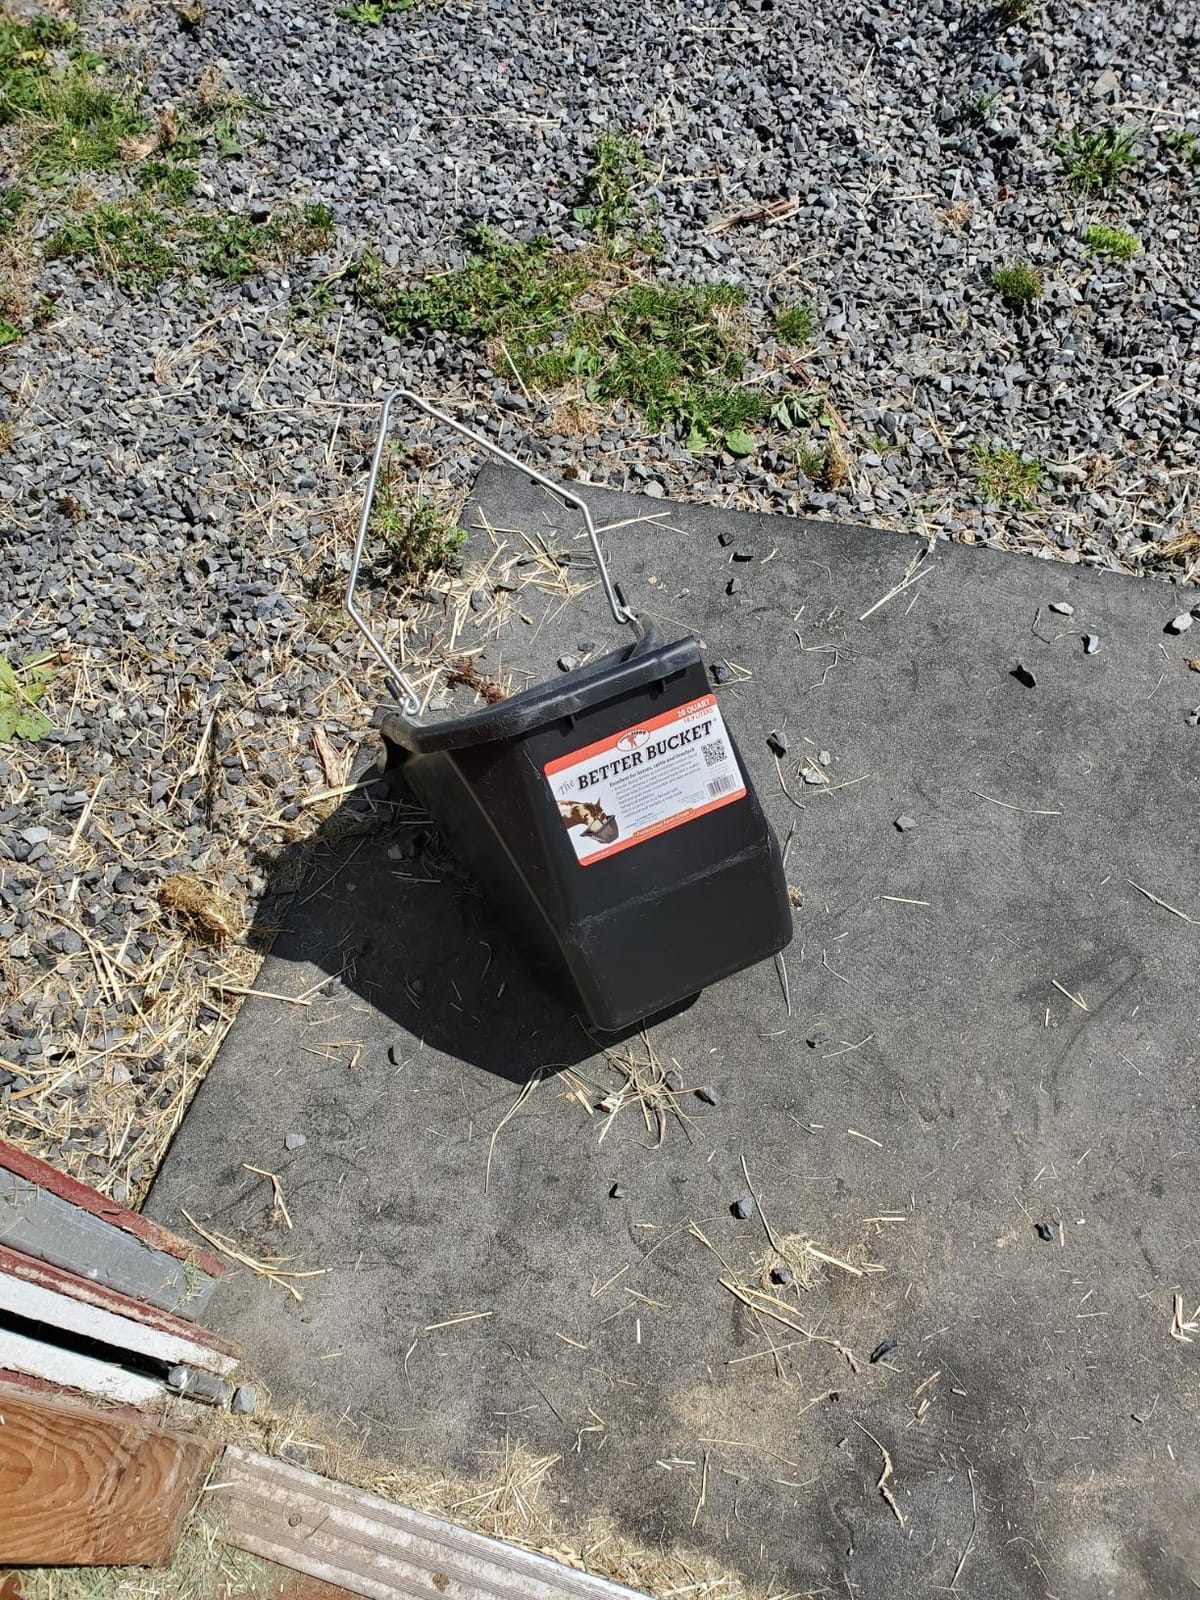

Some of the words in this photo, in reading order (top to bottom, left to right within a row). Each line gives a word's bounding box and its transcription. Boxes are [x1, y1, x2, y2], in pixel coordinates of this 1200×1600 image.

[677, 709, 686, 718] 20
[687, 699, 710, 714] QUART
[559, 779, 576, 796] The
[577, 751, 643, 790] BETTER
[646, 720, 712, 761] BUCKET
